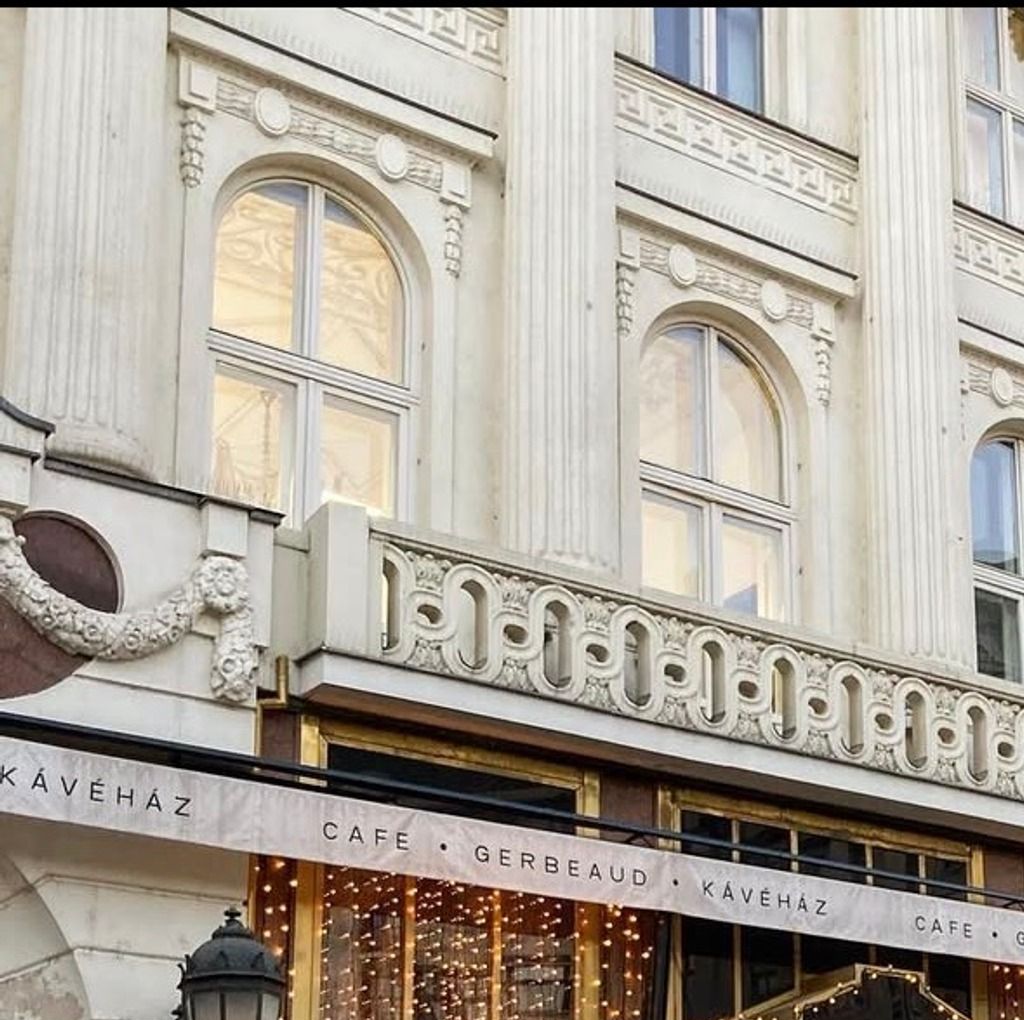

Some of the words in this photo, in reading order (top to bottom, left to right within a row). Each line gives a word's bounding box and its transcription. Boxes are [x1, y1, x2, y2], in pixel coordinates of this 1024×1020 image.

[0, 765, 192, 817] KÁVÉHÁZ
[323, 822, 409, 851] CAFE
[475, 845, 648, 886] GERBEAUD
[702, 880, 829, 917] KÁVÉHÁZ
[915, 916, 973, 938] CAFE
